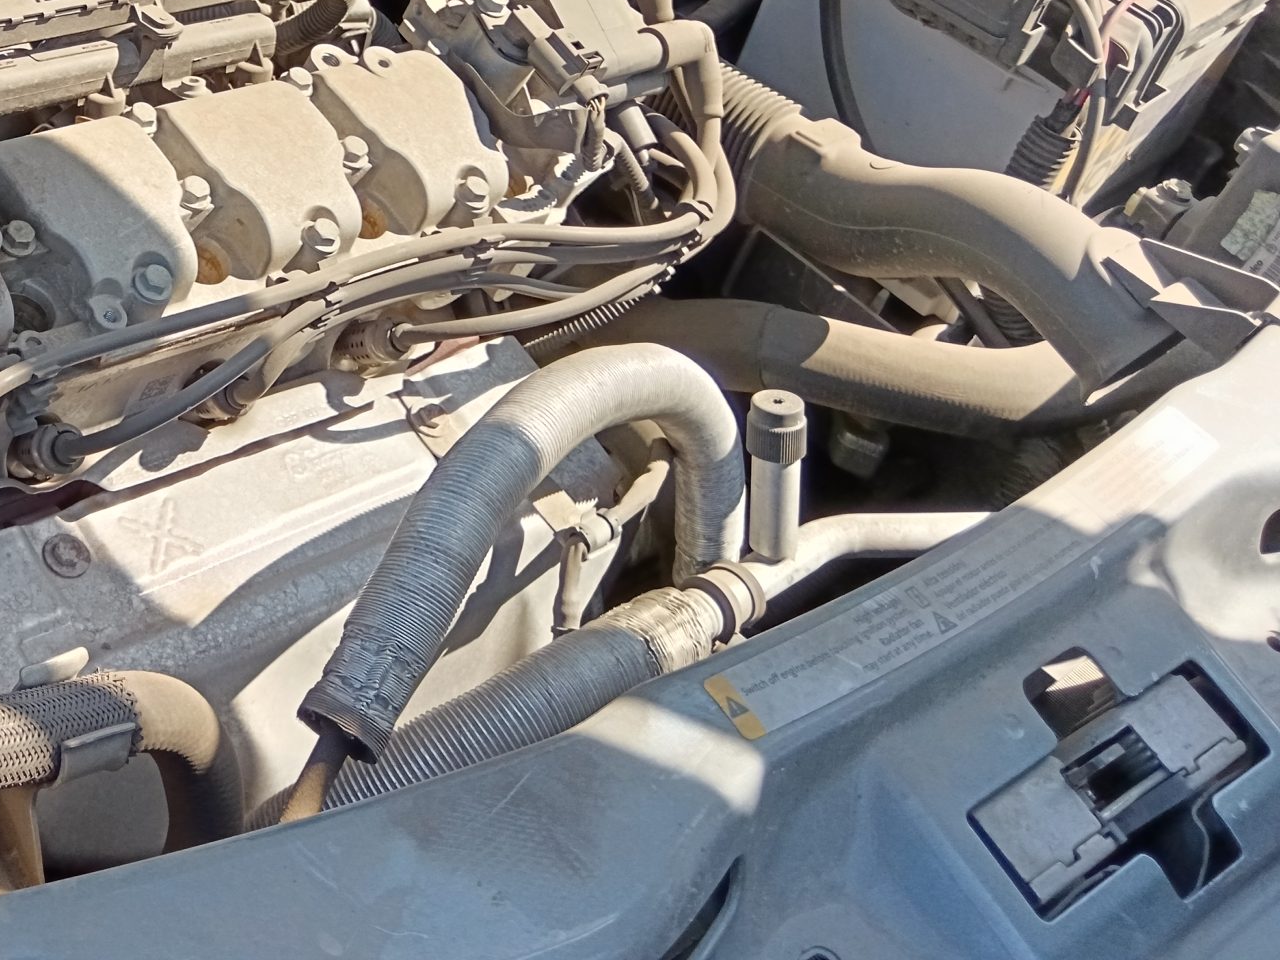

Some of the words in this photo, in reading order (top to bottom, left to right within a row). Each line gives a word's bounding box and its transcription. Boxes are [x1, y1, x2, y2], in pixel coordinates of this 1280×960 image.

[878, 651, 896, 666] start
[740, 679, 768, 696] Switch
[768, 674, 781, 685] off
[780, 661, 805, 680] engine
